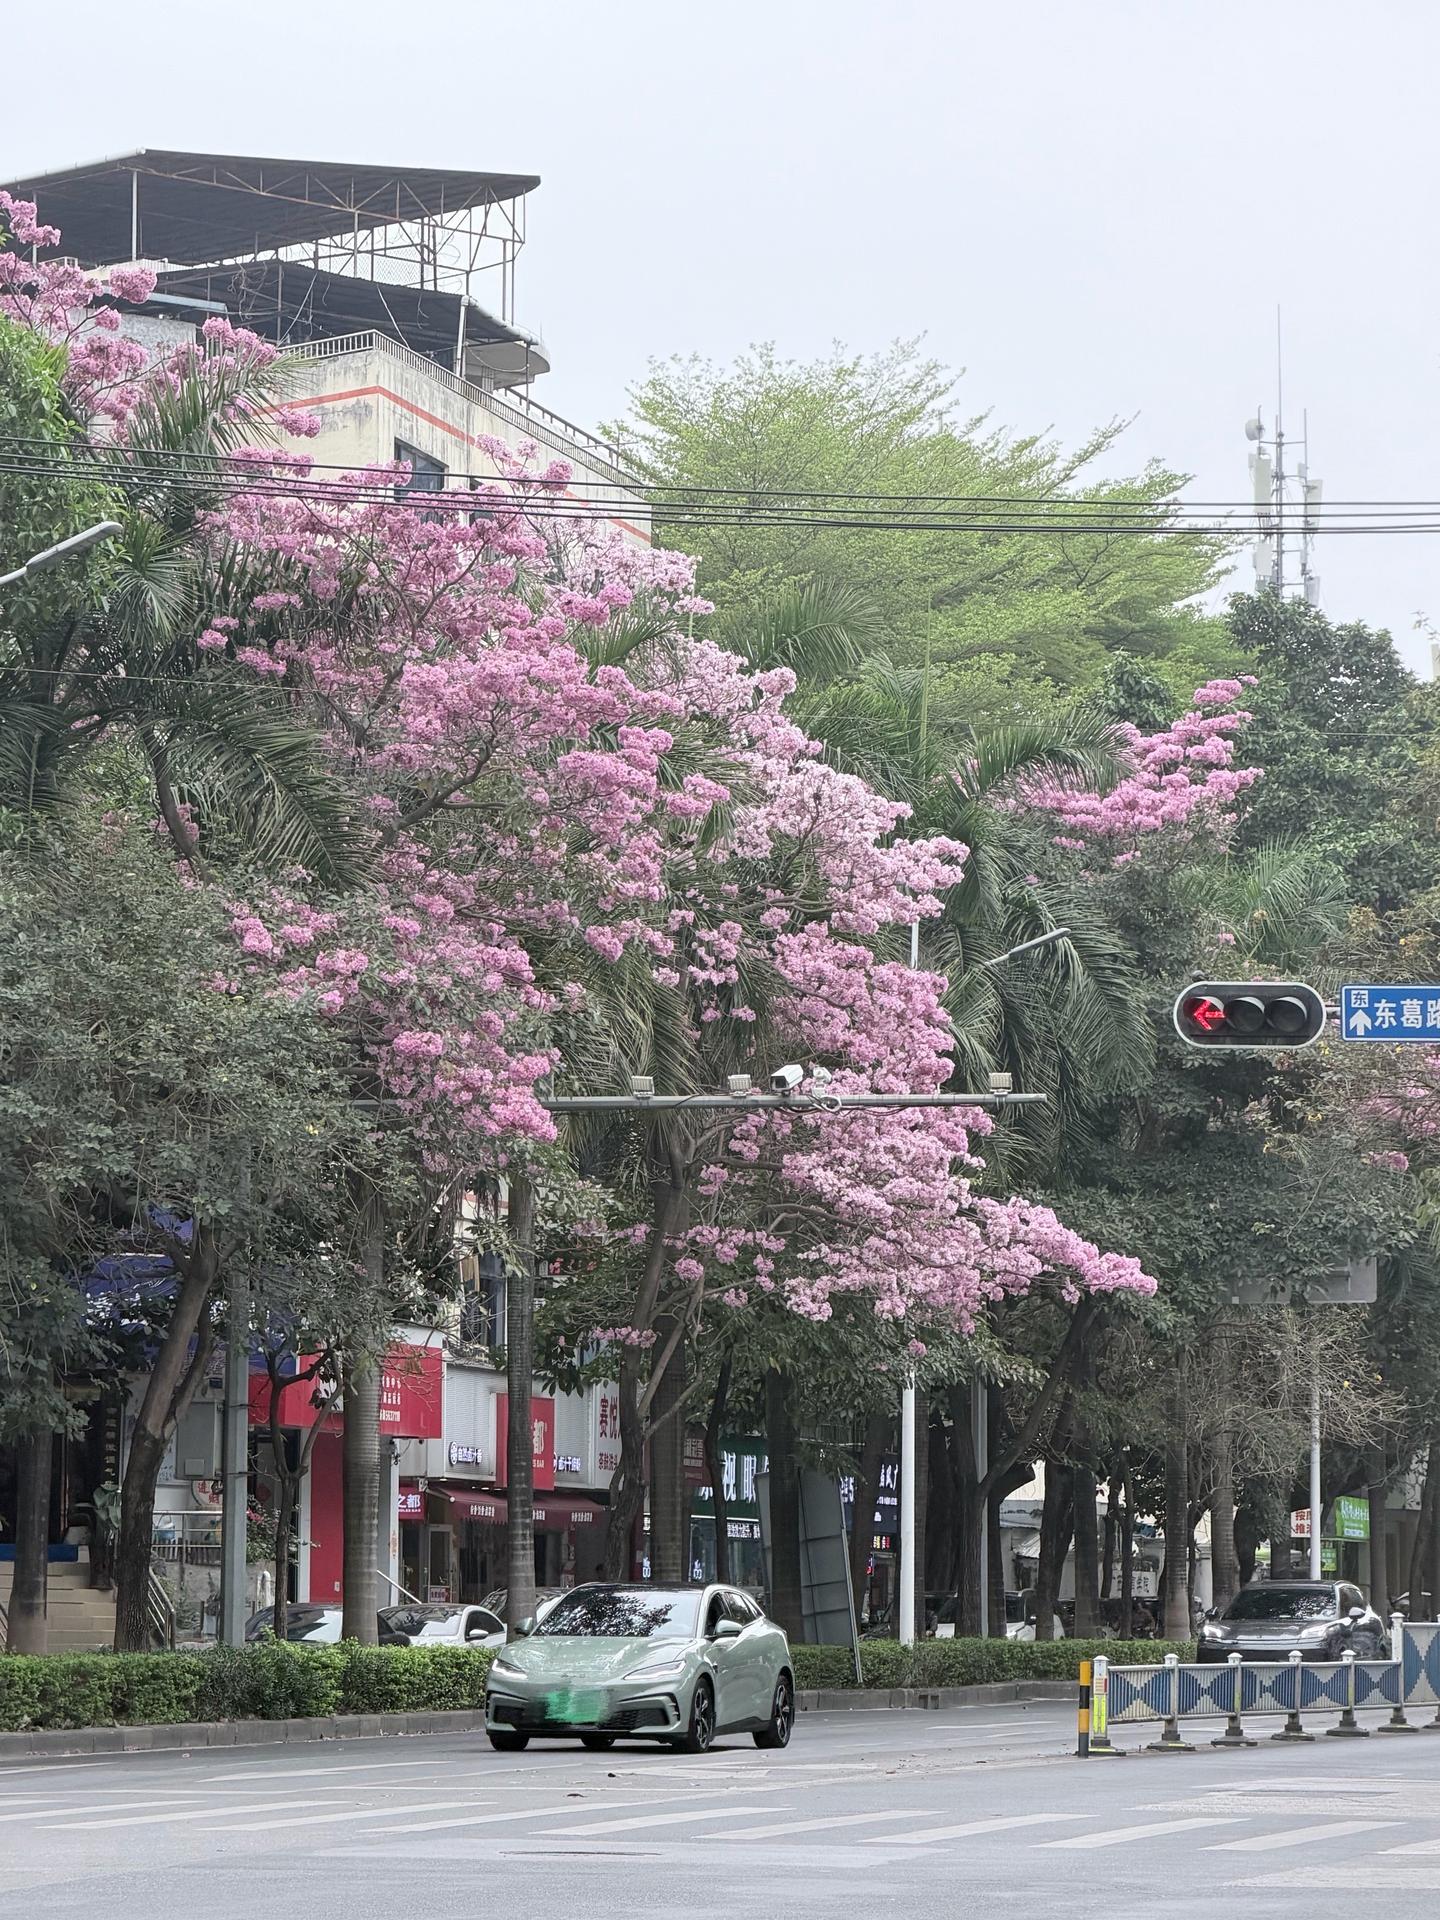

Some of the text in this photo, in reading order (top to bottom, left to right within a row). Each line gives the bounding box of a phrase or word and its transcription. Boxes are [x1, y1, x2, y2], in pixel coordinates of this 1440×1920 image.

[1352, 990, 1368, 1007] 东
[1374, 999, 1440, 1029] 东葛路
[600, 1394, 620, 1439] 赛悦
